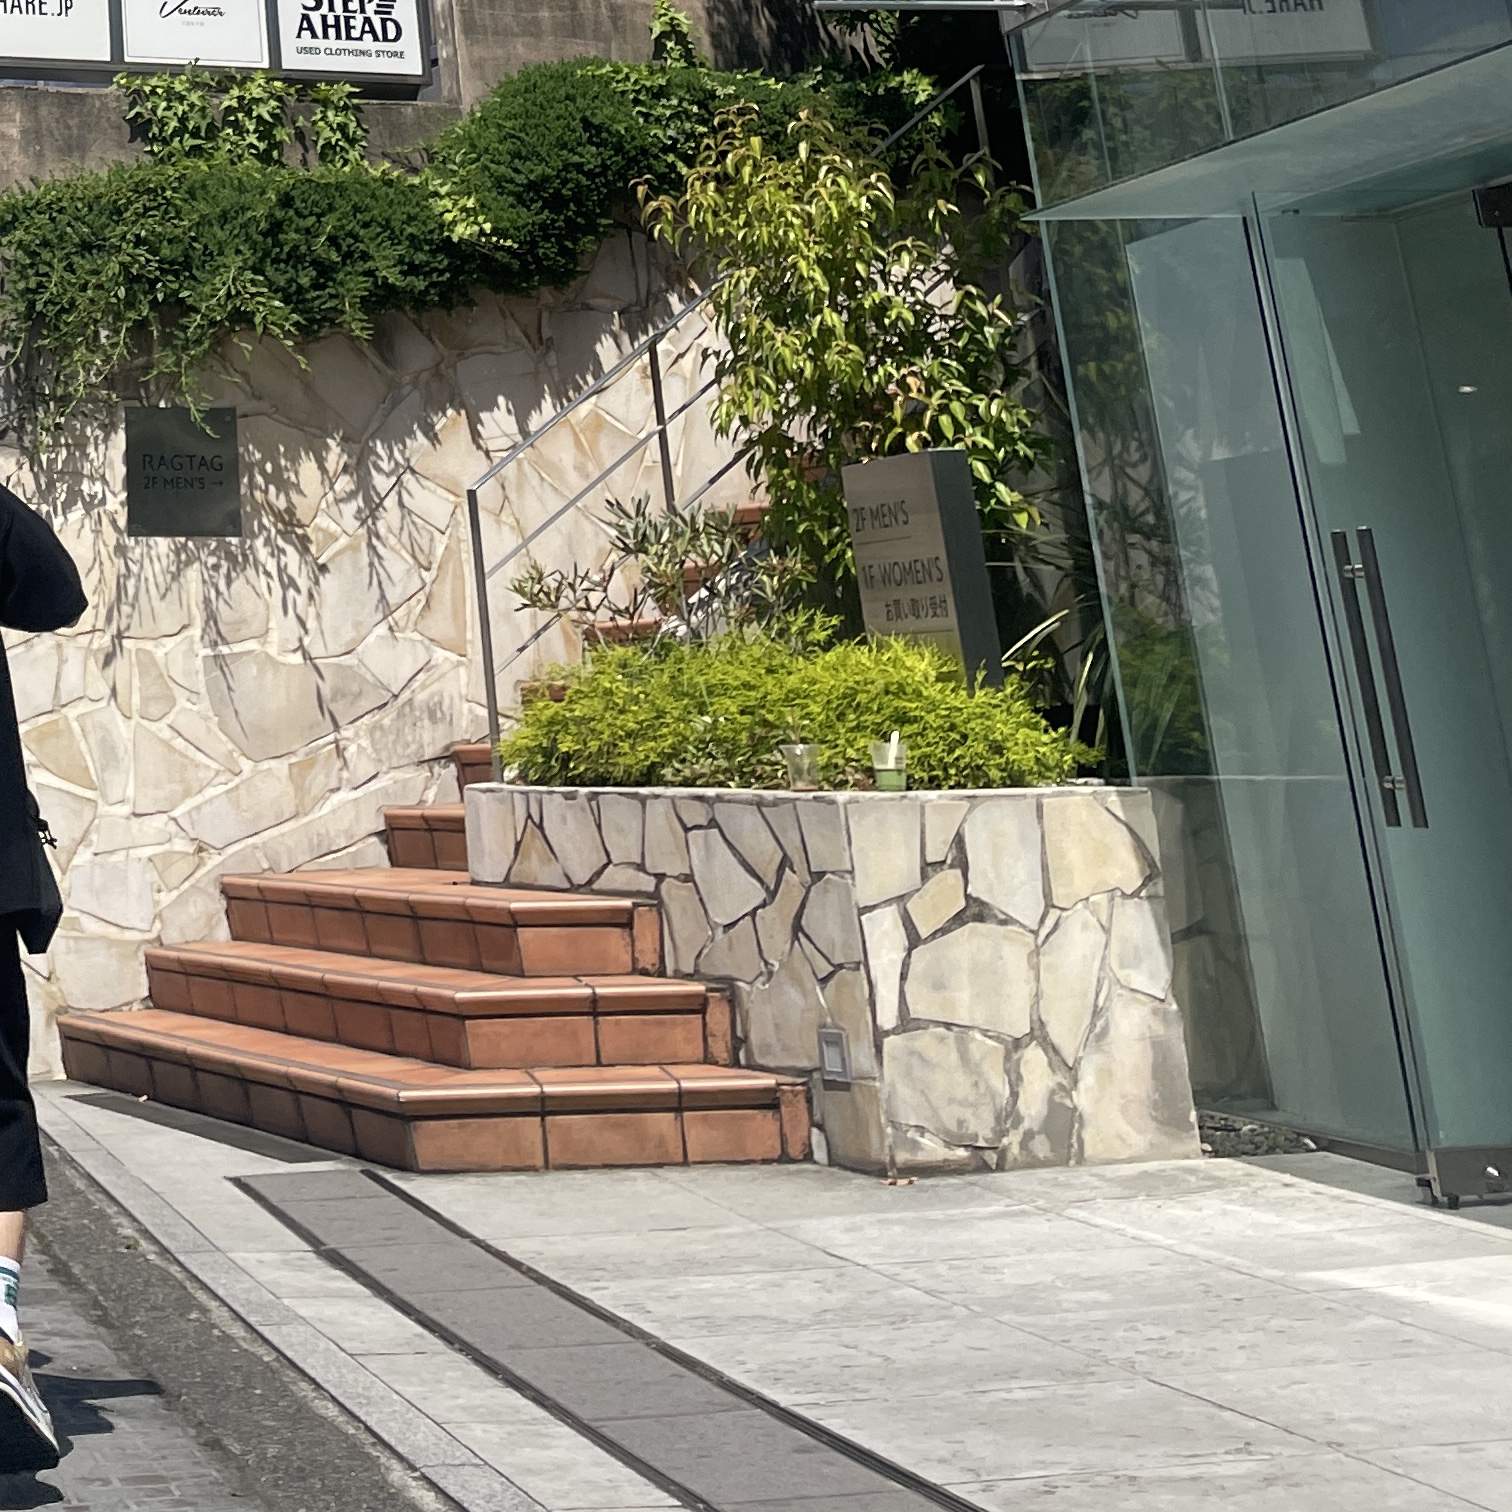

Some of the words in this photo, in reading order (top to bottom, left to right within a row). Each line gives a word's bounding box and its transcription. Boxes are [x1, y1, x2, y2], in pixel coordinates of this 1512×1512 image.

[295, 13, 403, 43] AHEAD
[296, 46, 322, 56] USED
[324, 47, 373, 58] CLOTHING
[375, 49, 405, 59] STORE
[142, 454, 224, 472] RAGTAG
[143, 476, 159, 490] 2F
[163, 476, 206, 490] MEN'S
[852, 507, 867, 533] 2F
[870, 500, 910, 530] MEN'S
[861, 564, 876, 590] 1F
[876, 556, 944, 588] WOMEN'S
[884, 593, 949, 623] お買い取り受付
